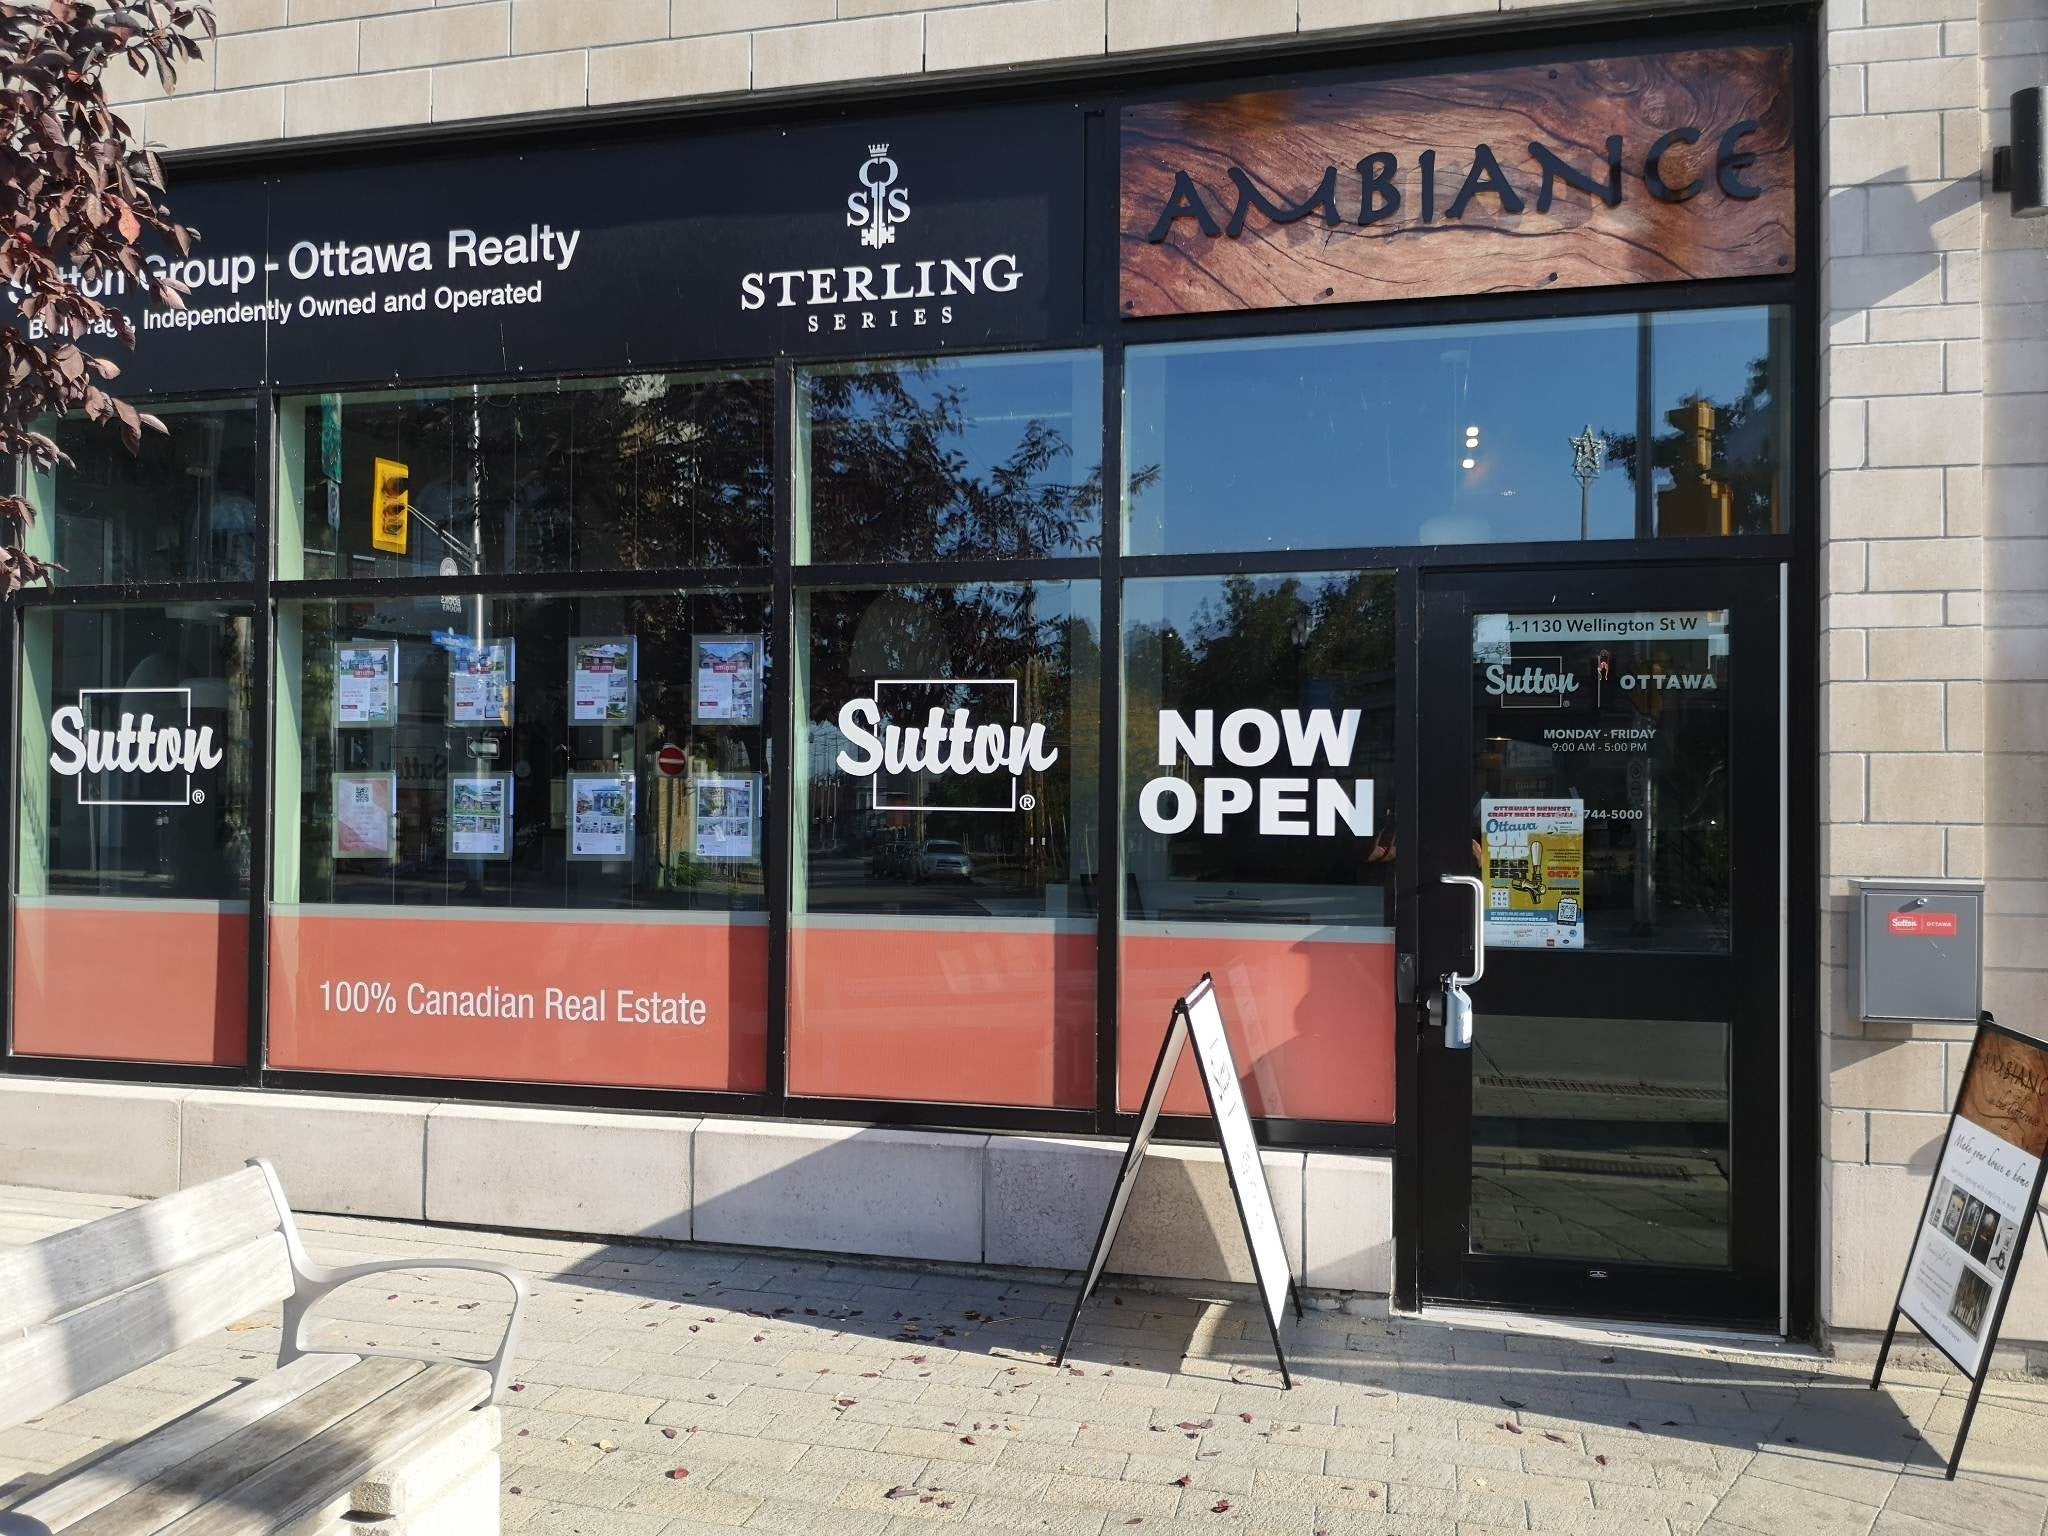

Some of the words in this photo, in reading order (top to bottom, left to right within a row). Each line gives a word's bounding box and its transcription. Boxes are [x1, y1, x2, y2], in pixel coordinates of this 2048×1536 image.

[1148, 120, 1762, 244] AMBIANCE
[288, 240, 432, 280] Ottawa
[447, 223, 582, 271] Realty
[144, 296, 292, 330] Independently
[299, 289, 376, 319] Owned
[384, 284, 427, 313] and
[434, 280, 543, 309] Operated
[741, 254, 1024, 310] STERLING
[807, 306, 953, 333] SERIES
[1505, 619, 1562, 633] 4-1130
[1566, 617, 1654, 635] Wellington
[1659, 618, 1675, 631] St
[1680, 617, 1698, 631] W
[1484, 664, 1579, 695] Sutton
[1619, 674, 1718, 690] OTTAWA
[50, 706, 223, 776] Sutton
[836, 698, 1058, 776] Sutton
[1158, 707, 1362, 767] NOW
[1543, 729, 1601, 739] MONDAY
[1610, 729, 1657, 739] FRIDAY
[1551, 742, 1575, 752] 9:00
[1577, 742, 1596, 752] AM
[1604, 742, 1627, 752] 5:00
[1632, 742, 1647, 752] PM
[1138, 776, 1375, 837] OPEN
[1486, 818, 1538, 834] Ottawa
[319, 980, 397, 1014] 100%
[407, 983, 534, 1019] Canadian
[545, 987, 606, 1022] Real
[617, 990, 707, 1025] Estate
